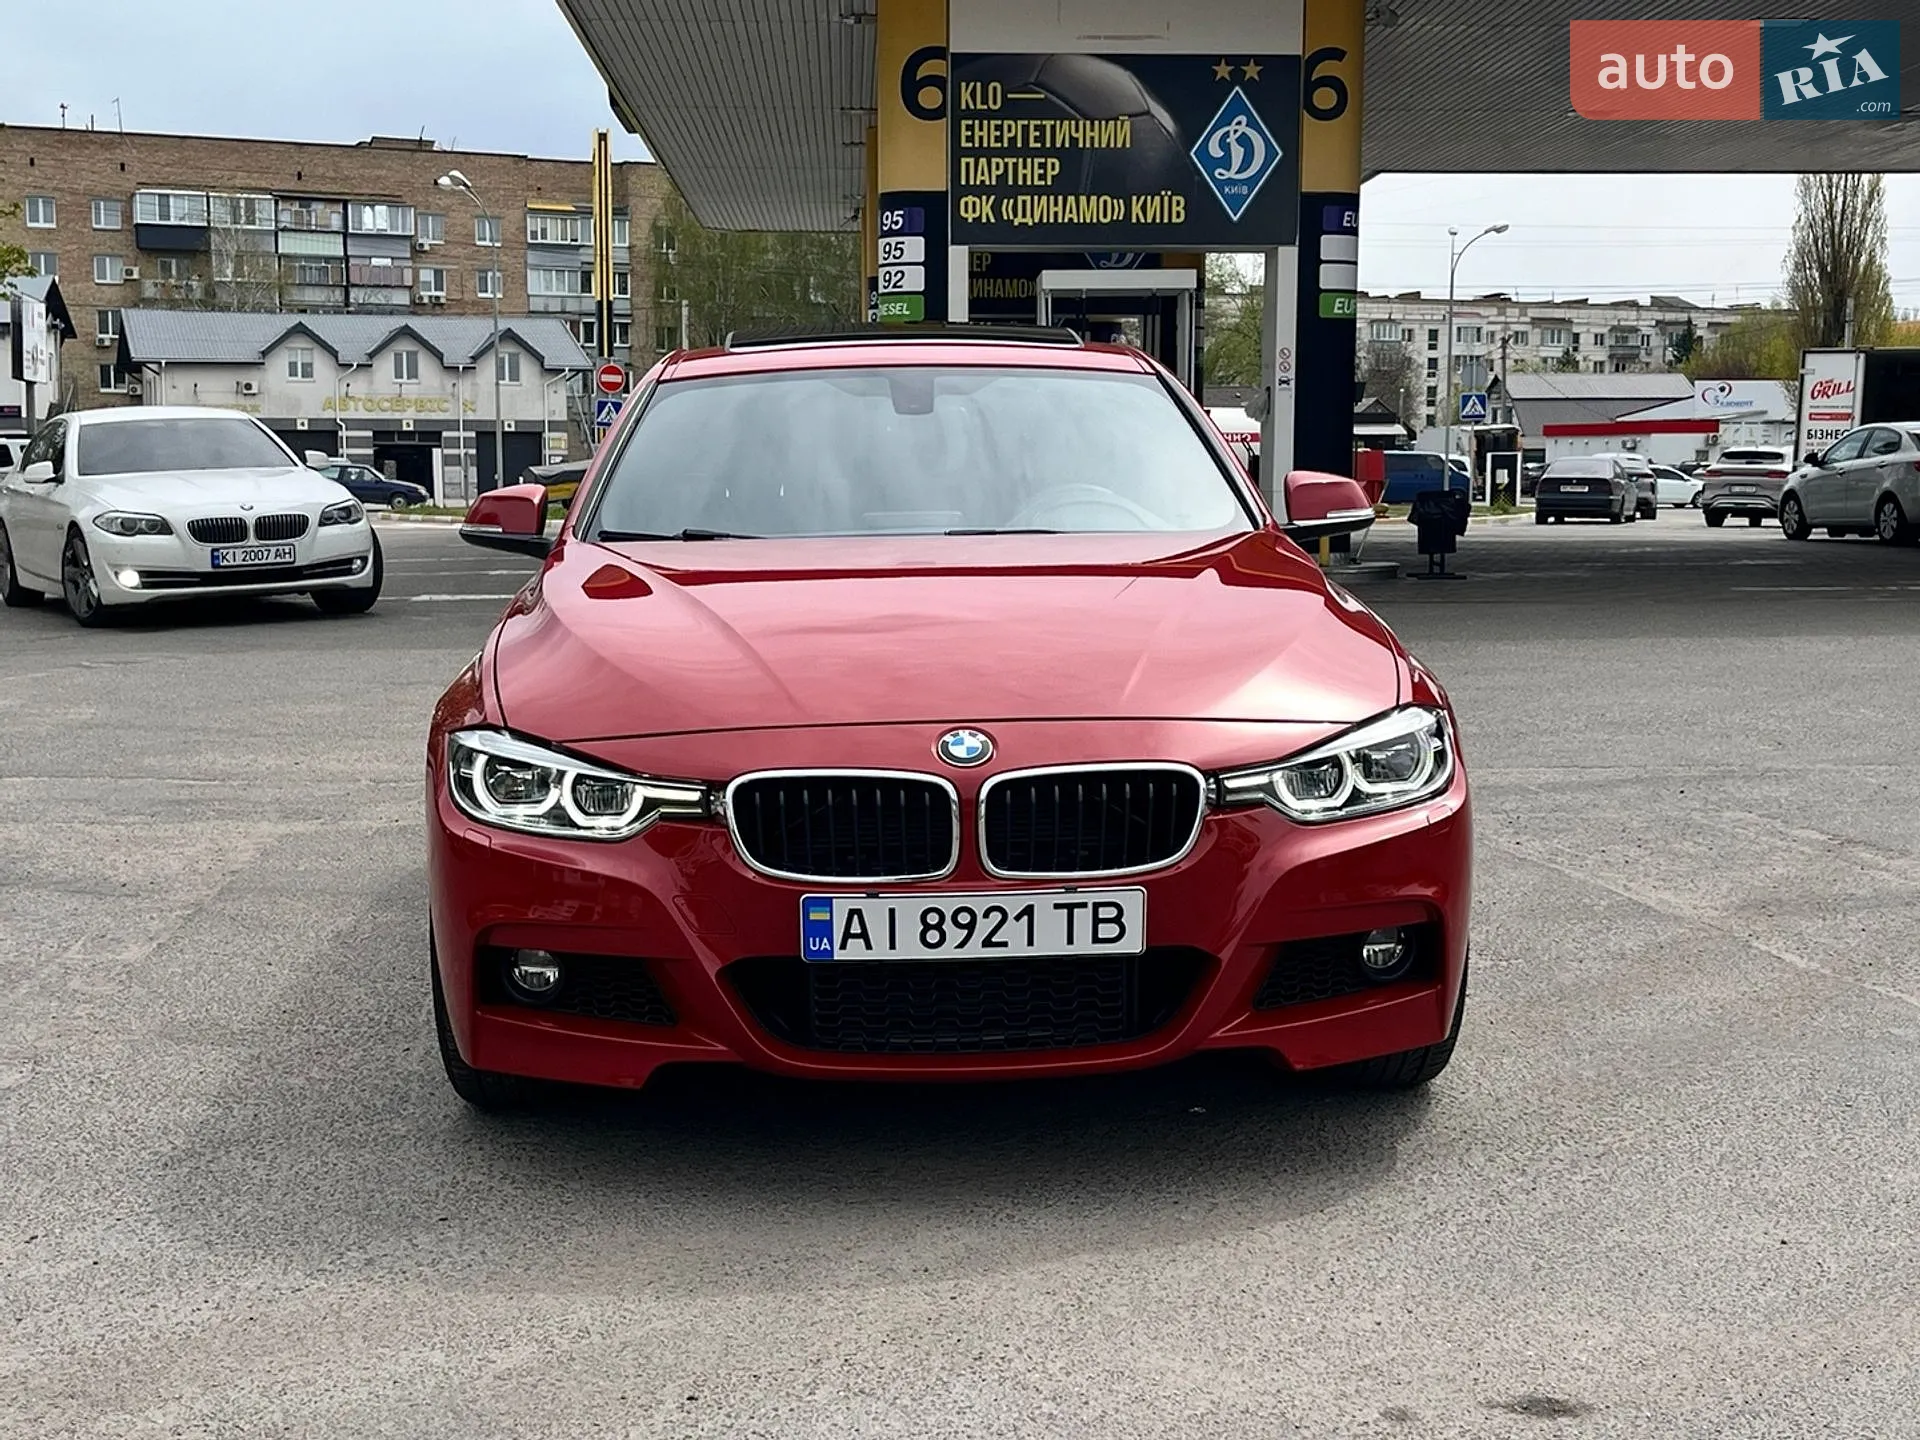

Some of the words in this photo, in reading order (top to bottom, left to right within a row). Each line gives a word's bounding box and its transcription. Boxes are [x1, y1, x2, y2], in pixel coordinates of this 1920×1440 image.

[900, 45, 947, 121] 6
[960, 81, 1002, 110] KLO
[1302, 47, 1349, 121] 6
[960, 116, 1131, 148] ЕНЕРГЕТИЧНИЙ
[960, 157, 1060, 186] ПАРТНЕР
[882, 211, 904, 231] 95
[960, 195, 996, 223] ФК
[1002, 195, 1125, 226] «ДИНАМО»
[1131, 190, 1186, 224] КИЇВ
[882, 241, 905, 261] 95
[882, 270, 905, 290] 92
[1810, 380, 1855, 400] GRILL
[241, 549, 271, 562] 2007
[274, 547, 292, 560] AH
[839, 907, 896, 950] AI
[918, 903, 1037, 950] 8921
[1052, 900, 1128, 946] TB
[809, 937, 831, 951] UA
